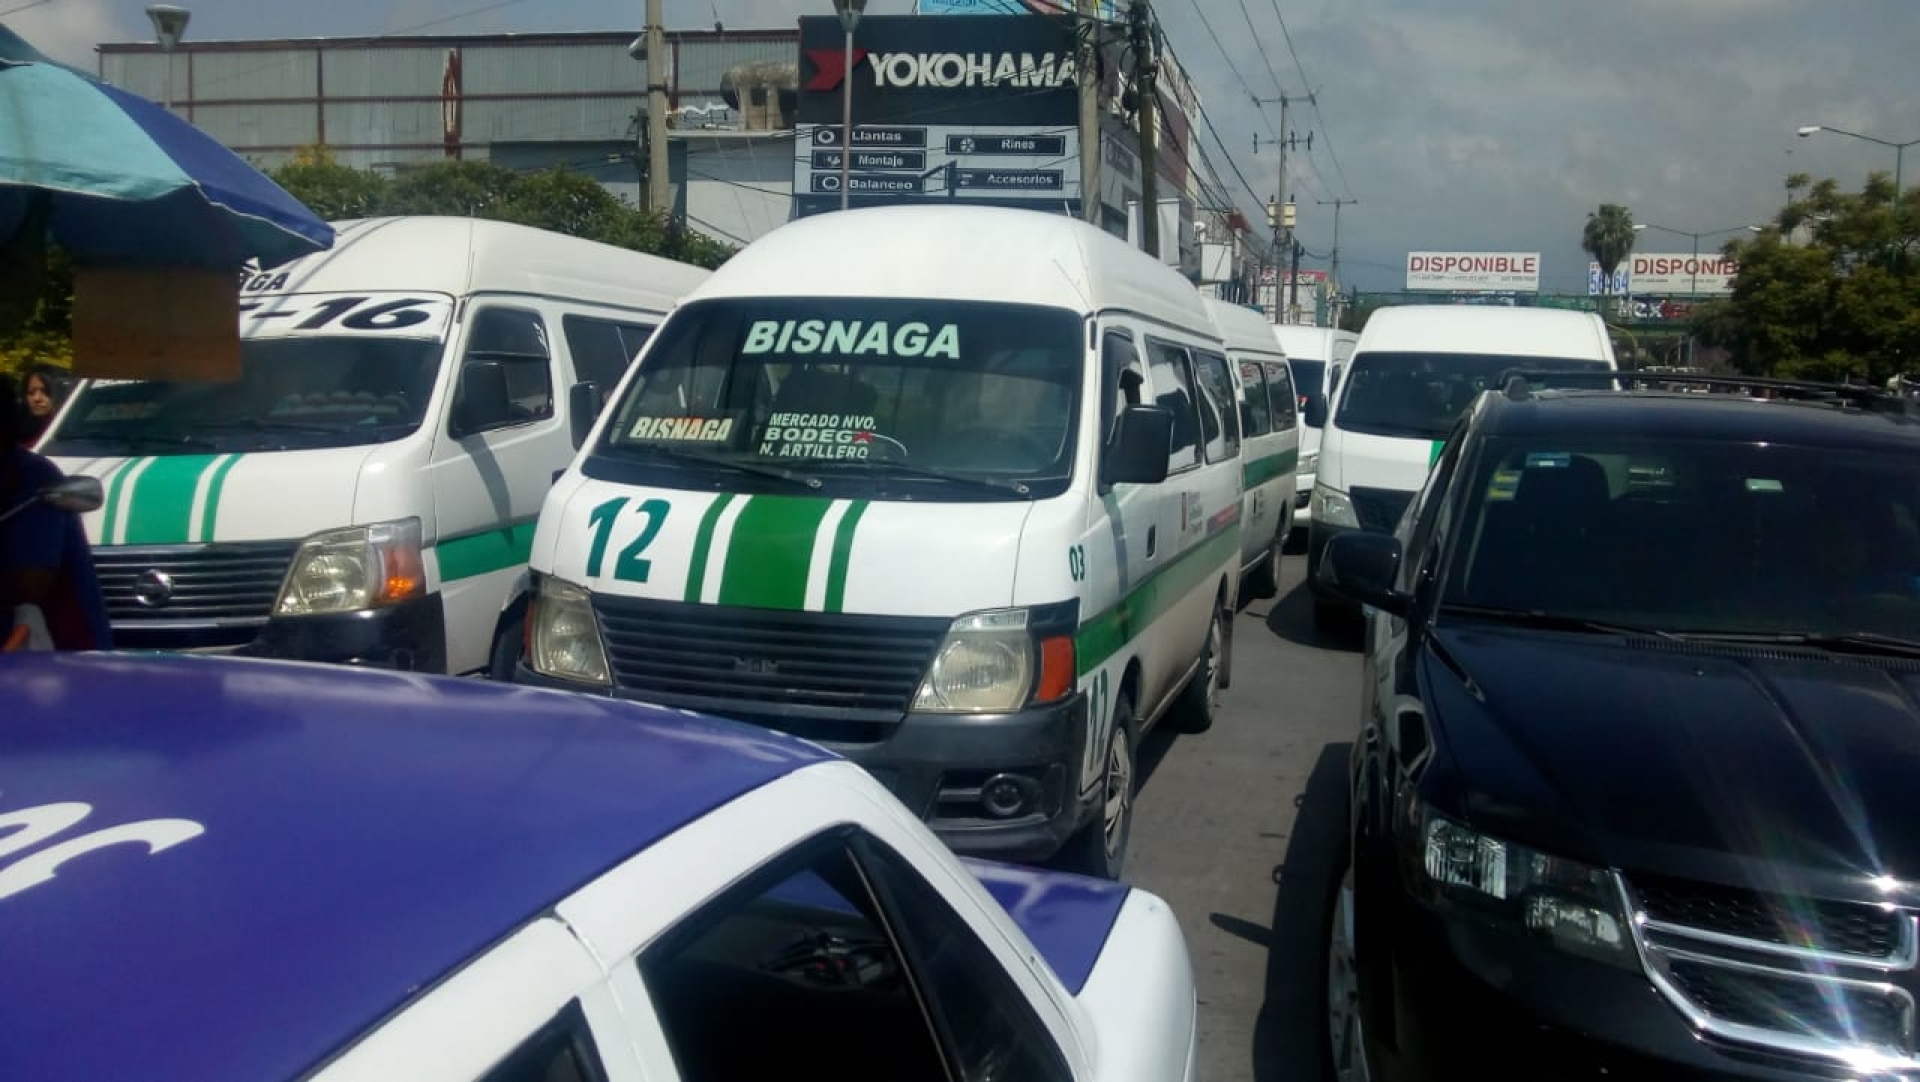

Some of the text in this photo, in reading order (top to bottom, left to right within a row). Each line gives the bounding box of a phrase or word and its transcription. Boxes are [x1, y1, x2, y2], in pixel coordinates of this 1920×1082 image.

[867, 51, 1080, 88] YOKOHAMA
[852, 131, 902, 142] Llantas
[1001, 139, 1035, 150] Rines
[859, 155, 903, 167] Montaje
[849, 179, 913, 190] Balanceo
[987, 174, 1053, 184] Accesorios
[1410, 256, 1537, 273] DISPONIBLE
[1634, 258, 1740, 275] DISPONIB
[742, 320, 961, 360] BISNAGA
[629, 416, 733, 442] BISNAGA
[769, 412, 877, 430] MERCADO NVO.
[759, 442, 869, 459] N. ARTILLERO
[586, 496, 671, 583] 12
[1069, 545, 1085, 581] 03
